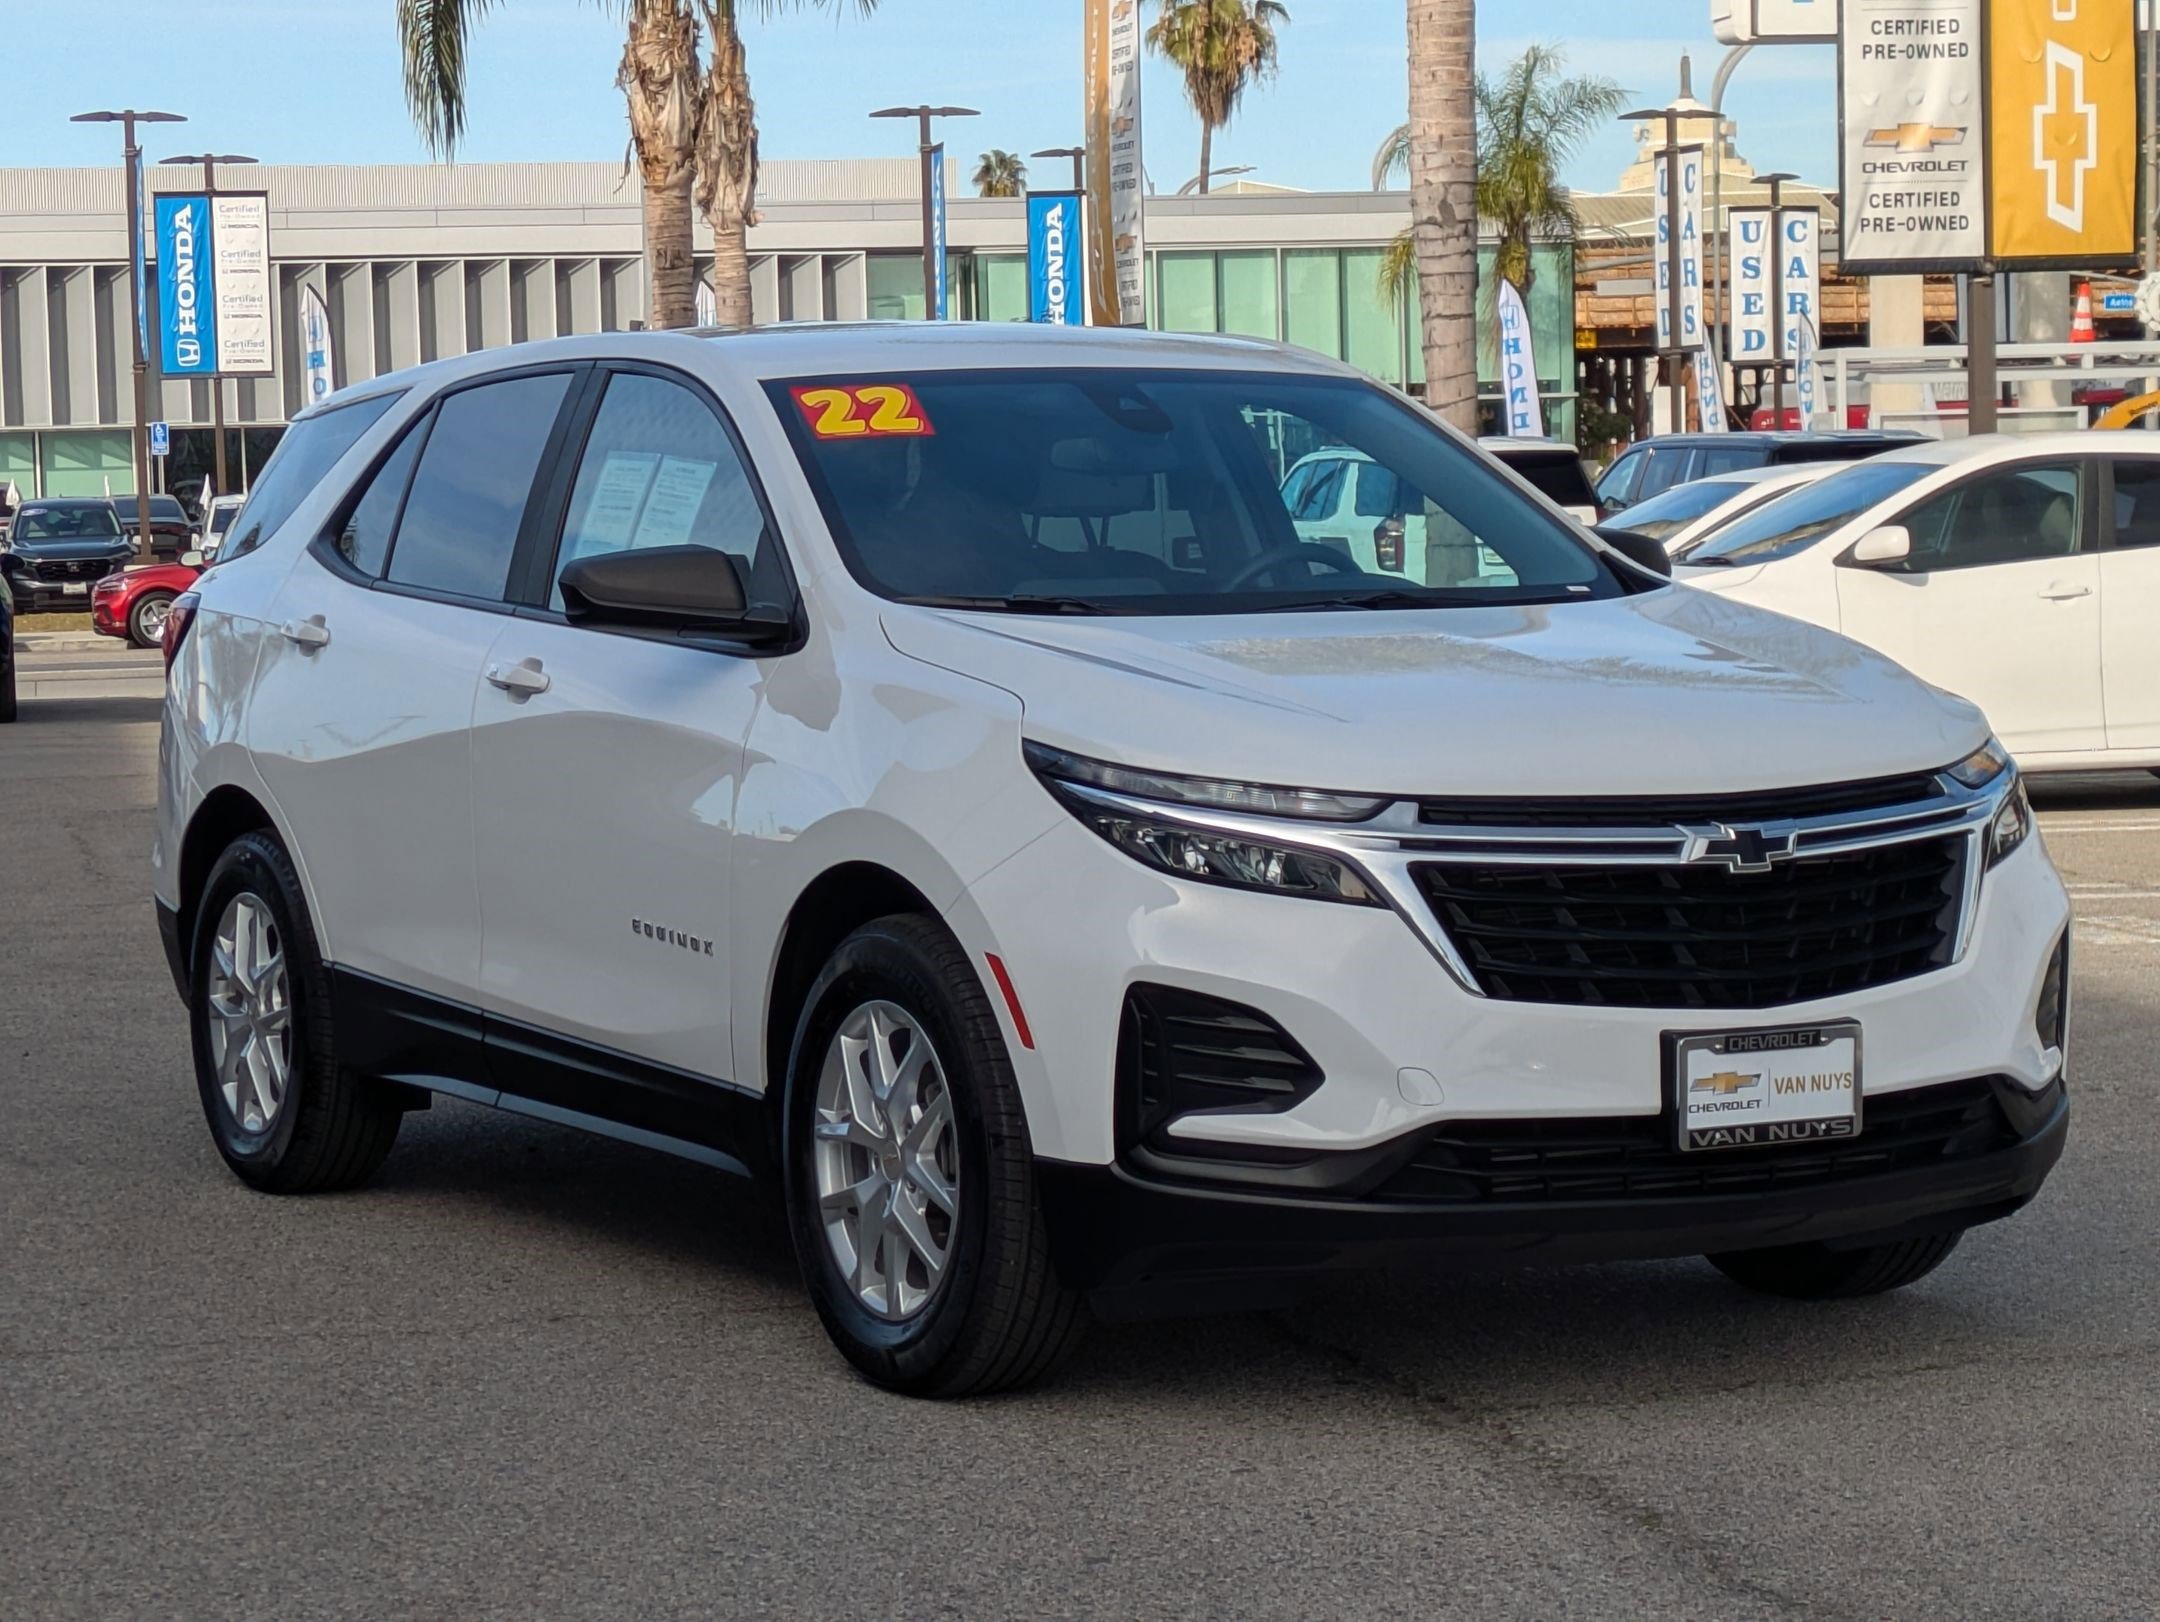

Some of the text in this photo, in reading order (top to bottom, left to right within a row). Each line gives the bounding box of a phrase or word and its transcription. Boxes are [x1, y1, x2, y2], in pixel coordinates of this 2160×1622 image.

[1871, 19, 1960, 35] CERTIFIED
[1862, 42, 1969, 59] PRE-OWNED
[1862, 160, 1969, 174] CHEVROLET
[1869, 191, 1960, 208] CERTIFIED
[219, 204, 260, 213] Certified
[1860, 215, 1969, 233] PRE-OWNED
[221, 249, 261, 258] Certified
[1682, 163, 1698, 335] CARS
[175, 204, 197, 336] HONDA
[1740, 220, 1766, 352] USED
[222, 294, 263, 303] Certified
[224, 339, 265, 348] Certified
[800, 386, 923, 435] 22
[632, 919, 713, 957] EQUINOX
[1729, 1031, 1817, 1051] CHEVROLET
[1774, 1072, 1852, 1095] VAN NUYS
[1688, 1098, 1762, 1114] CHEVROLET
[1692, 1119, 1851, 1147] VAN NUYS
